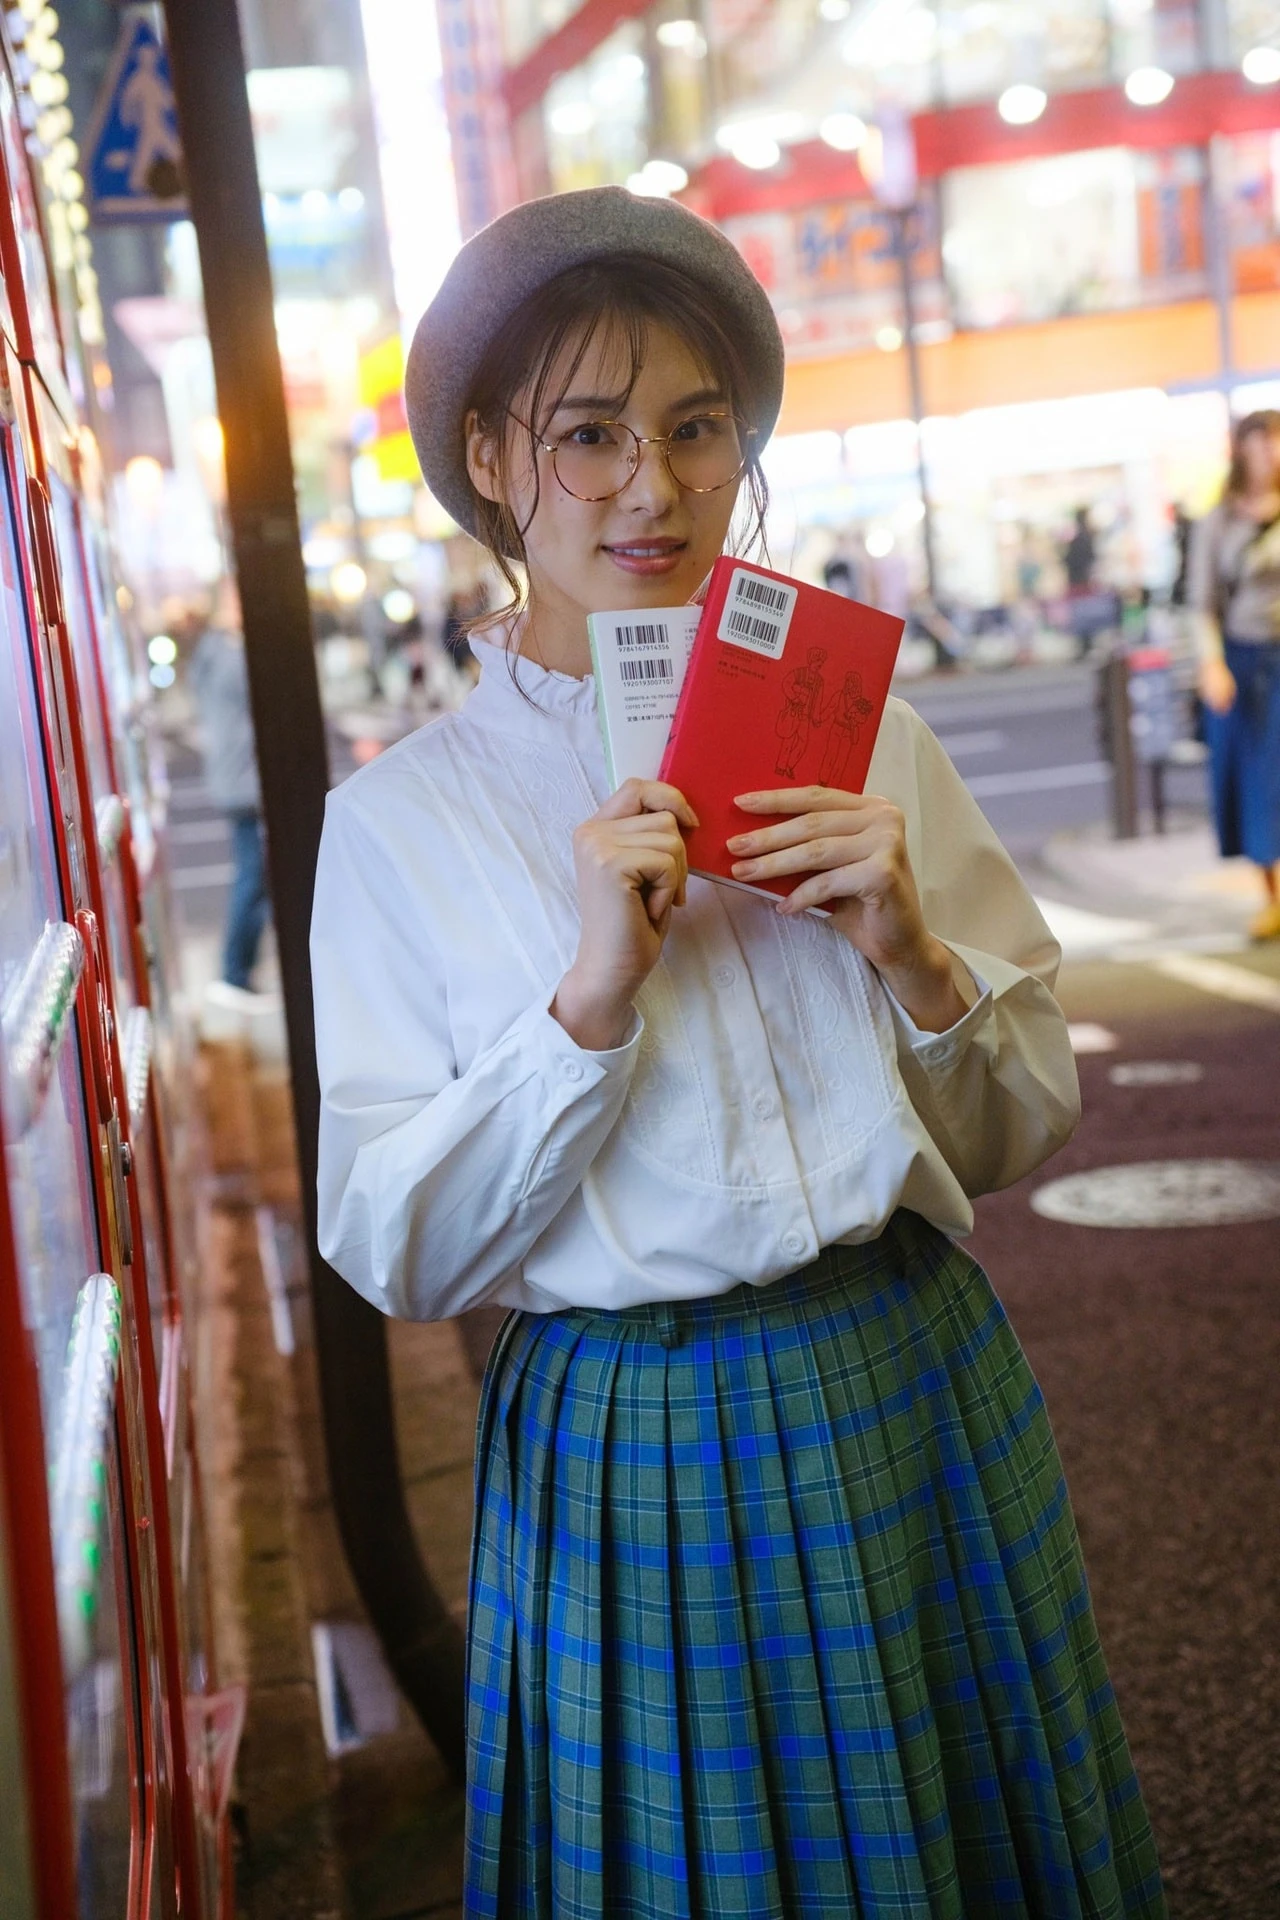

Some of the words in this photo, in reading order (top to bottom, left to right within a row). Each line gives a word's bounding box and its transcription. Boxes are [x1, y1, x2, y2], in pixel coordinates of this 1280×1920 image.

[734, 597, 784, 618] 9784898155349
[726, 630, 776, 651] 1920093010009
[618, 645, 670, 653] 9784167914356
[623, 679, 674, 687] 1920193007107
